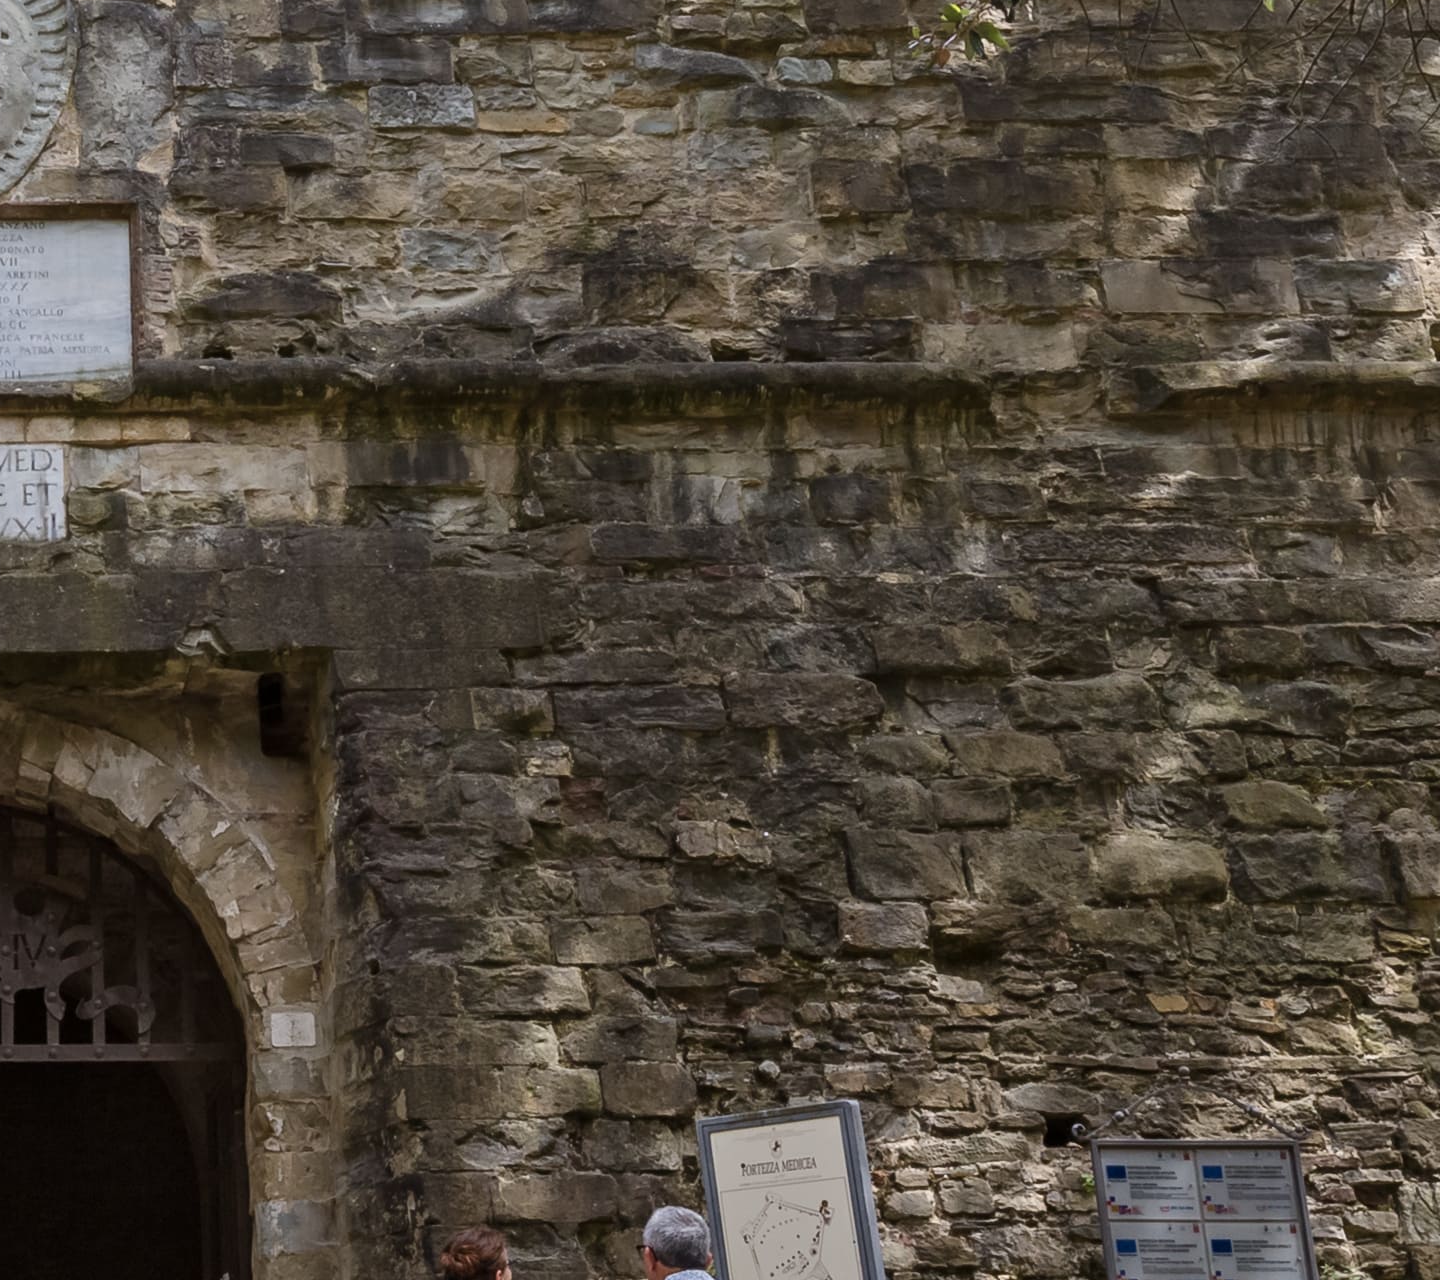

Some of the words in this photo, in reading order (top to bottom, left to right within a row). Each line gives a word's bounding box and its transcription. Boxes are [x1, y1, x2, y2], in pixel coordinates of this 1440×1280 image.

[6, 271, 50, 280] ARETINI
[8, 308, 65, 318] SANGALLO
[19, 346, 55, 356] PATRIA
[23, 483, 58, 507] ET
[781, 1157, 818, 1172] MEDICEA
